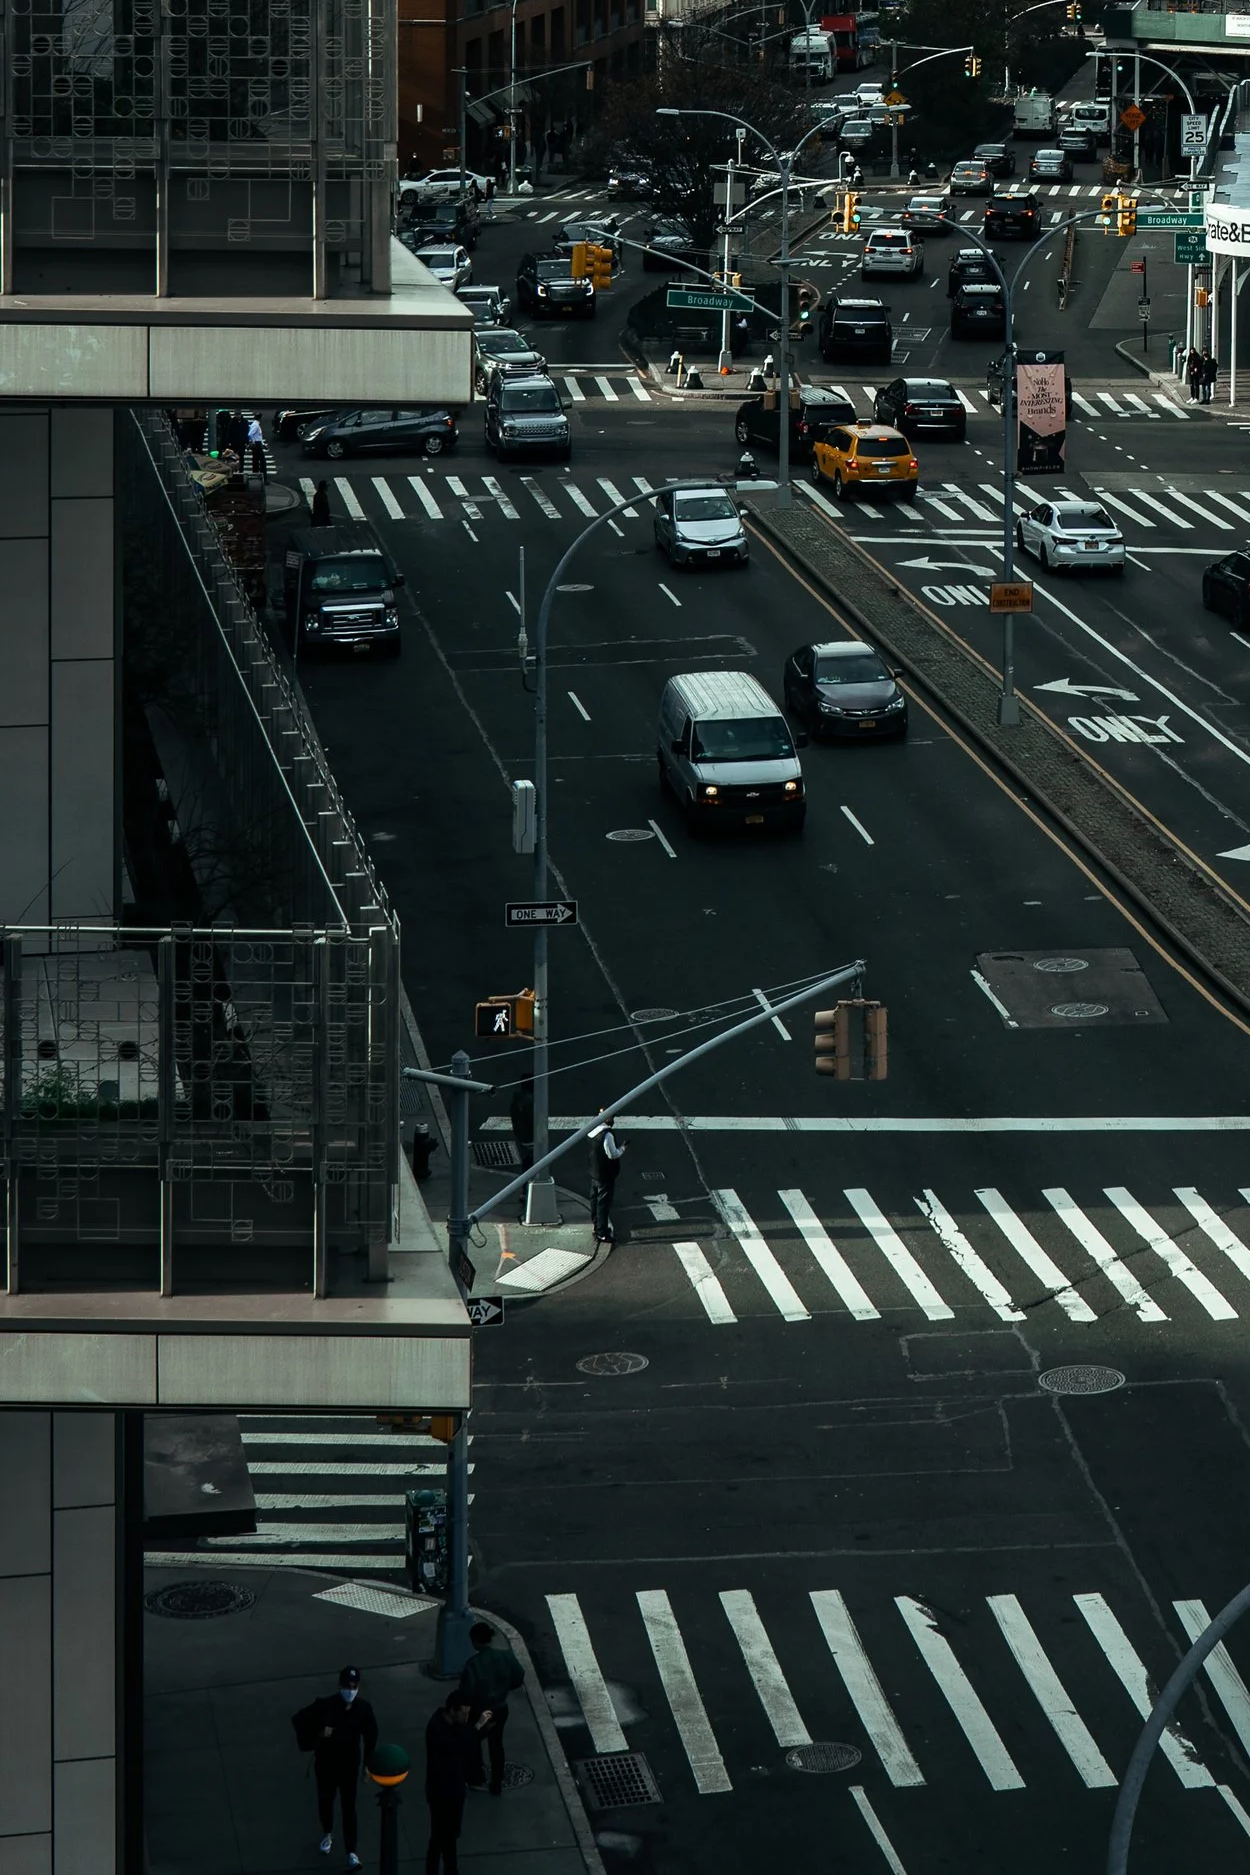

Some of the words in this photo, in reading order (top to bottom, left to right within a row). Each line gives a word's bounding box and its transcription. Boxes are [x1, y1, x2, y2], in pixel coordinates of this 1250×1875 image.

[1185, 131, 1204, 143] 25
[1147, 216, 1188, 226] Broadway
[1179, 253, 1194, 261] Hwy
[687, 295, 734, 308] Broadway
[1033, 377, 1050, 386] NoHo
[1020, 398, 1063, 406] INTERESTING
[1027, 404, 1057, 415] Brands
[921, 585, 990, 606] ONL
[1004, 588, 1020, 597] END
[992, 599, 1031, 608] CONSTRUCTION
[1067, 715, 1186, 743] ONLY
[516, 910, 537, 919] ONE
[545, 908, 567, 918] WAY
